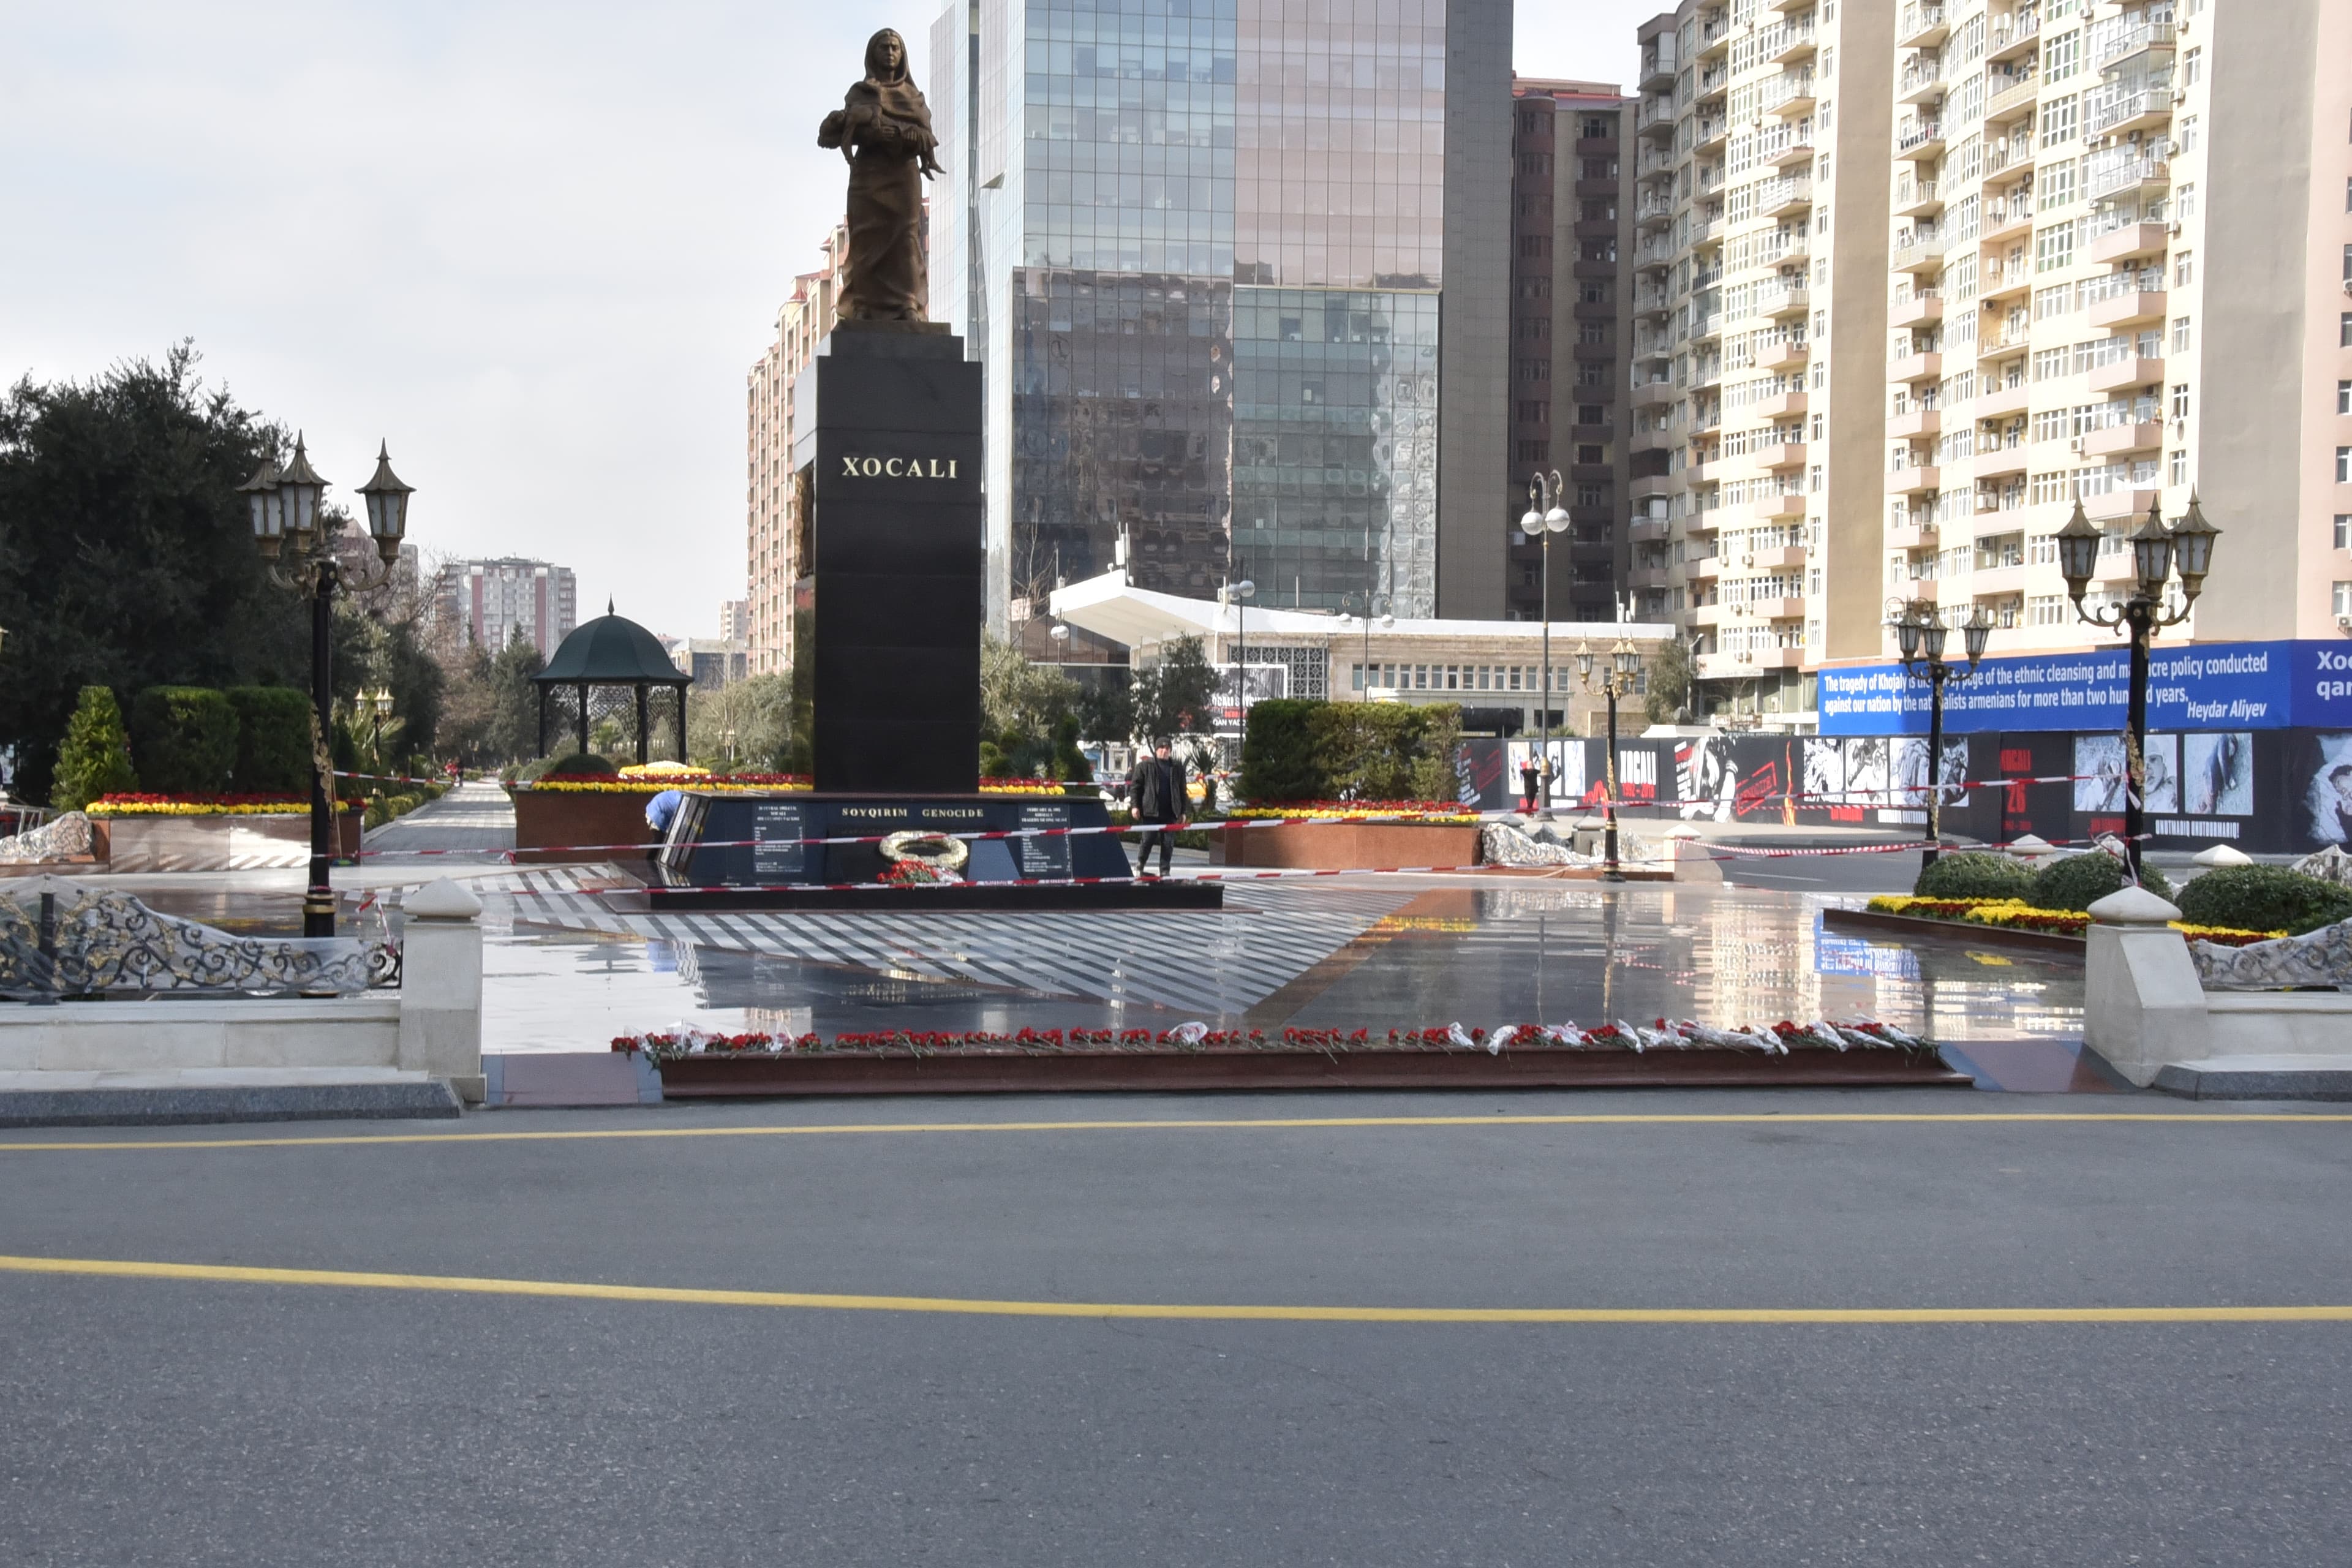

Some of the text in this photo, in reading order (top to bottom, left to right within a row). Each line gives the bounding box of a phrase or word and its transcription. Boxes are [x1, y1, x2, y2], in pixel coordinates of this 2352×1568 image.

[842, 457, 957, 478] XOCALI
[1825, 675, 1838, 692] The
[1839, 675, 1868, 695] tragedy
[1869, 673, 1878, 690] of
[1879, 672, 1907, 693] Khojaly
[1909, 673, 1915, 688] is
[1986, 667, 1995, 685] of
[1997, 666, 2013, 685] the
[2014, 665, 2045, 684] ethnic
[2046, 662, 2094, 685] cleansing
[2097, 660, 2116, 679] and
[2119, 662, 2168, 679] mcre
[2171, 655, 2203, 681] policy
[2206, 651, 2267, 674] conducted
[1825, 684, 2188, 716] against our nation by the natialists armenians for more than two hund years.
[2187, 699, 2267, 722] Heydar Aliyev
[1620, 750, 1656, 785] XOCALI
[842, 808, 984, 818] SOYQIRIM GENOCIDE
